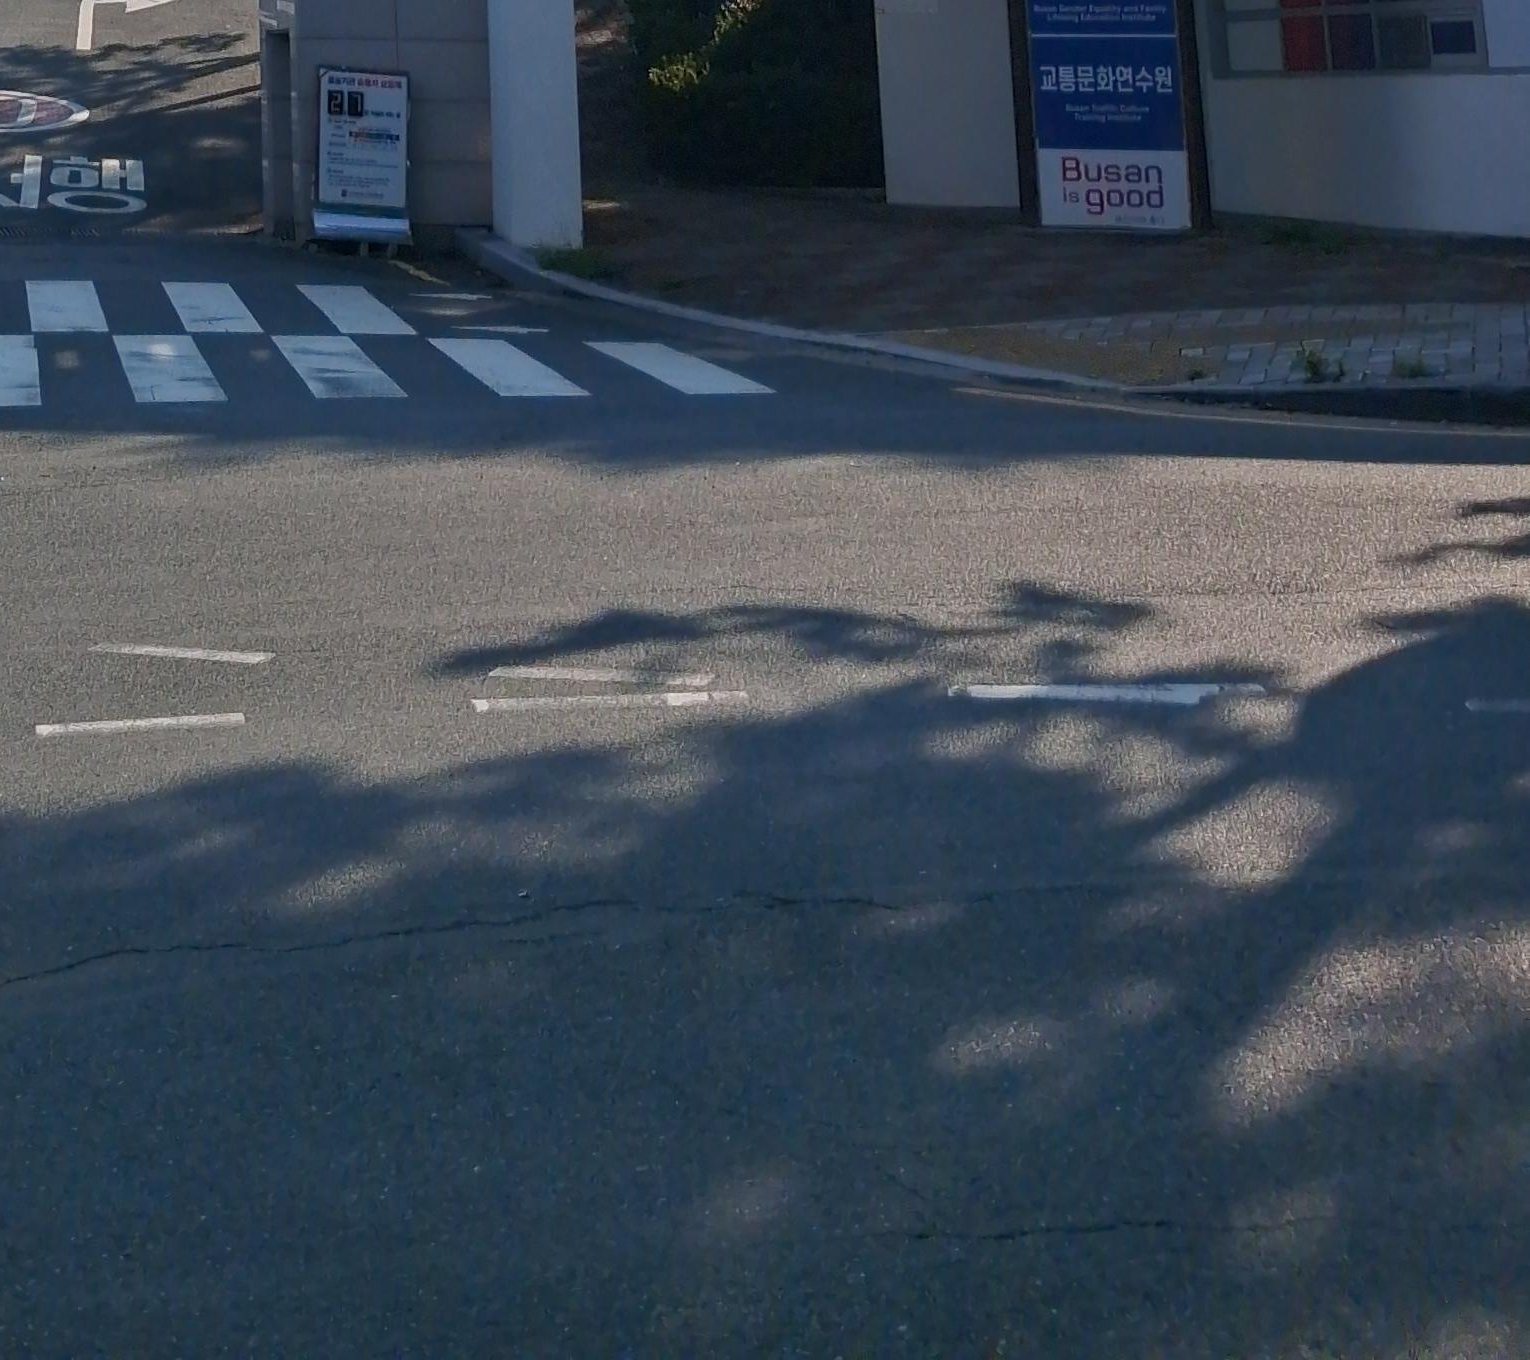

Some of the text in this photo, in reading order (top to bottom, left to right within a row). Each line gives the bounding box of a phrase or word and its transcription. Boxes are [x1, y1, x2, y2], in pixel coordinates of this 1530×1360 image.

[1039, 65, 1173, 92] 교통문화연수원
[1062, 156, 1163, 184] Busan
[1063, 184, 1164, 215] is good
